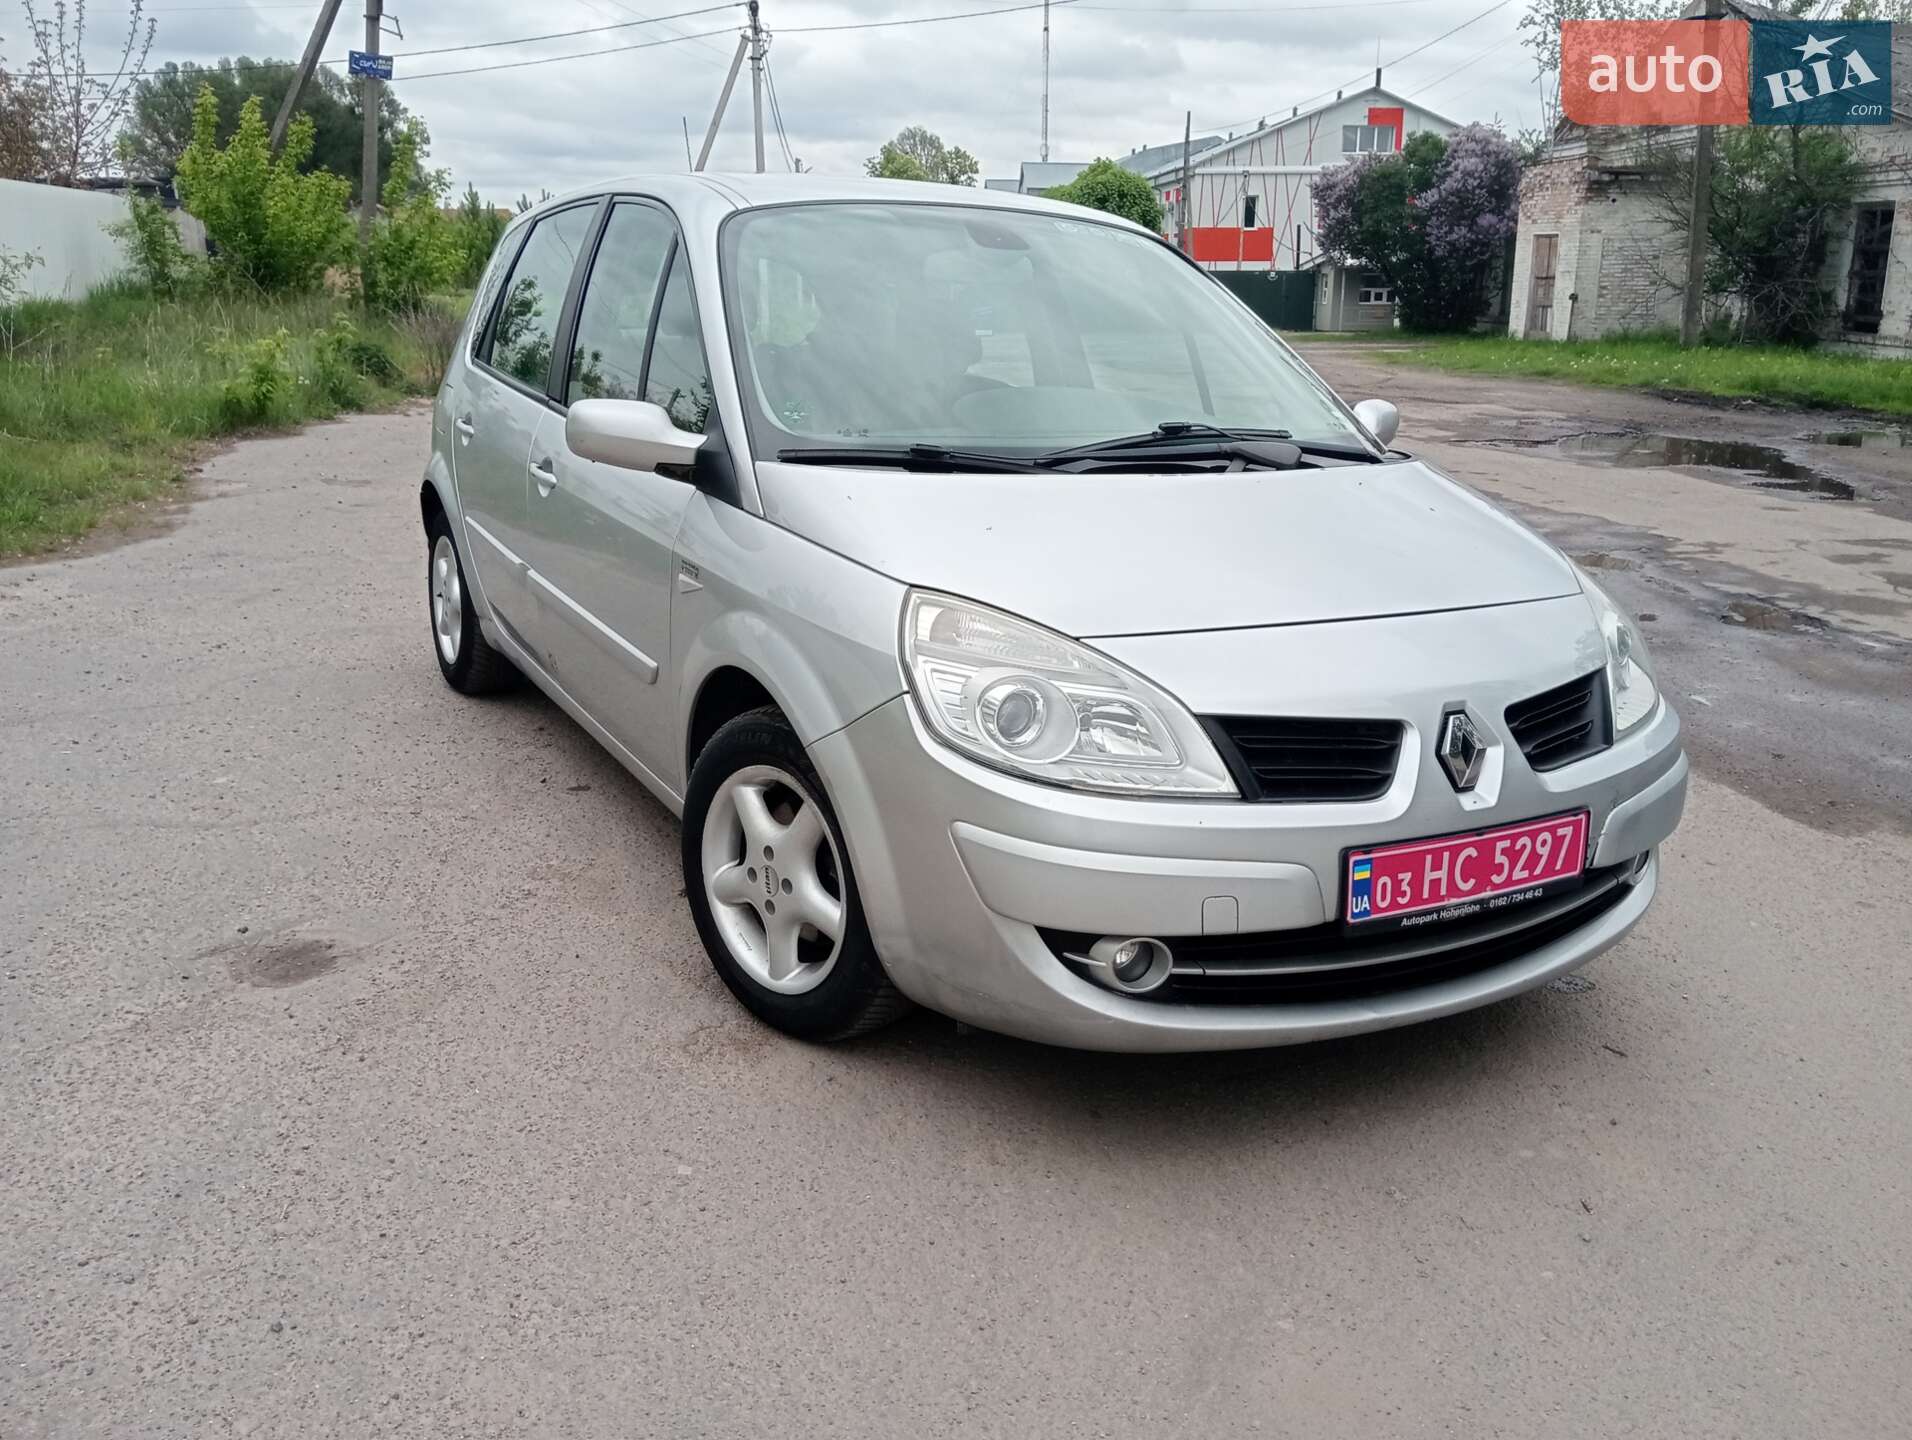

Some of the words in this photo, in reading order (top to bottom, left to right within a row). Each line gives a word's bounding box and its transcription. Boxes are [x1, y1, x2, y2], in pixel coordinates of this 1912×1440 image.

[1375, 871, 1413, 909] 03
[1421, 846, 1478, 899] HC
[1489, 825, 1575, 885] 5297
[1352, 895, 1371, 914] UA
[1400, 911, 1439, 927] Autopark
